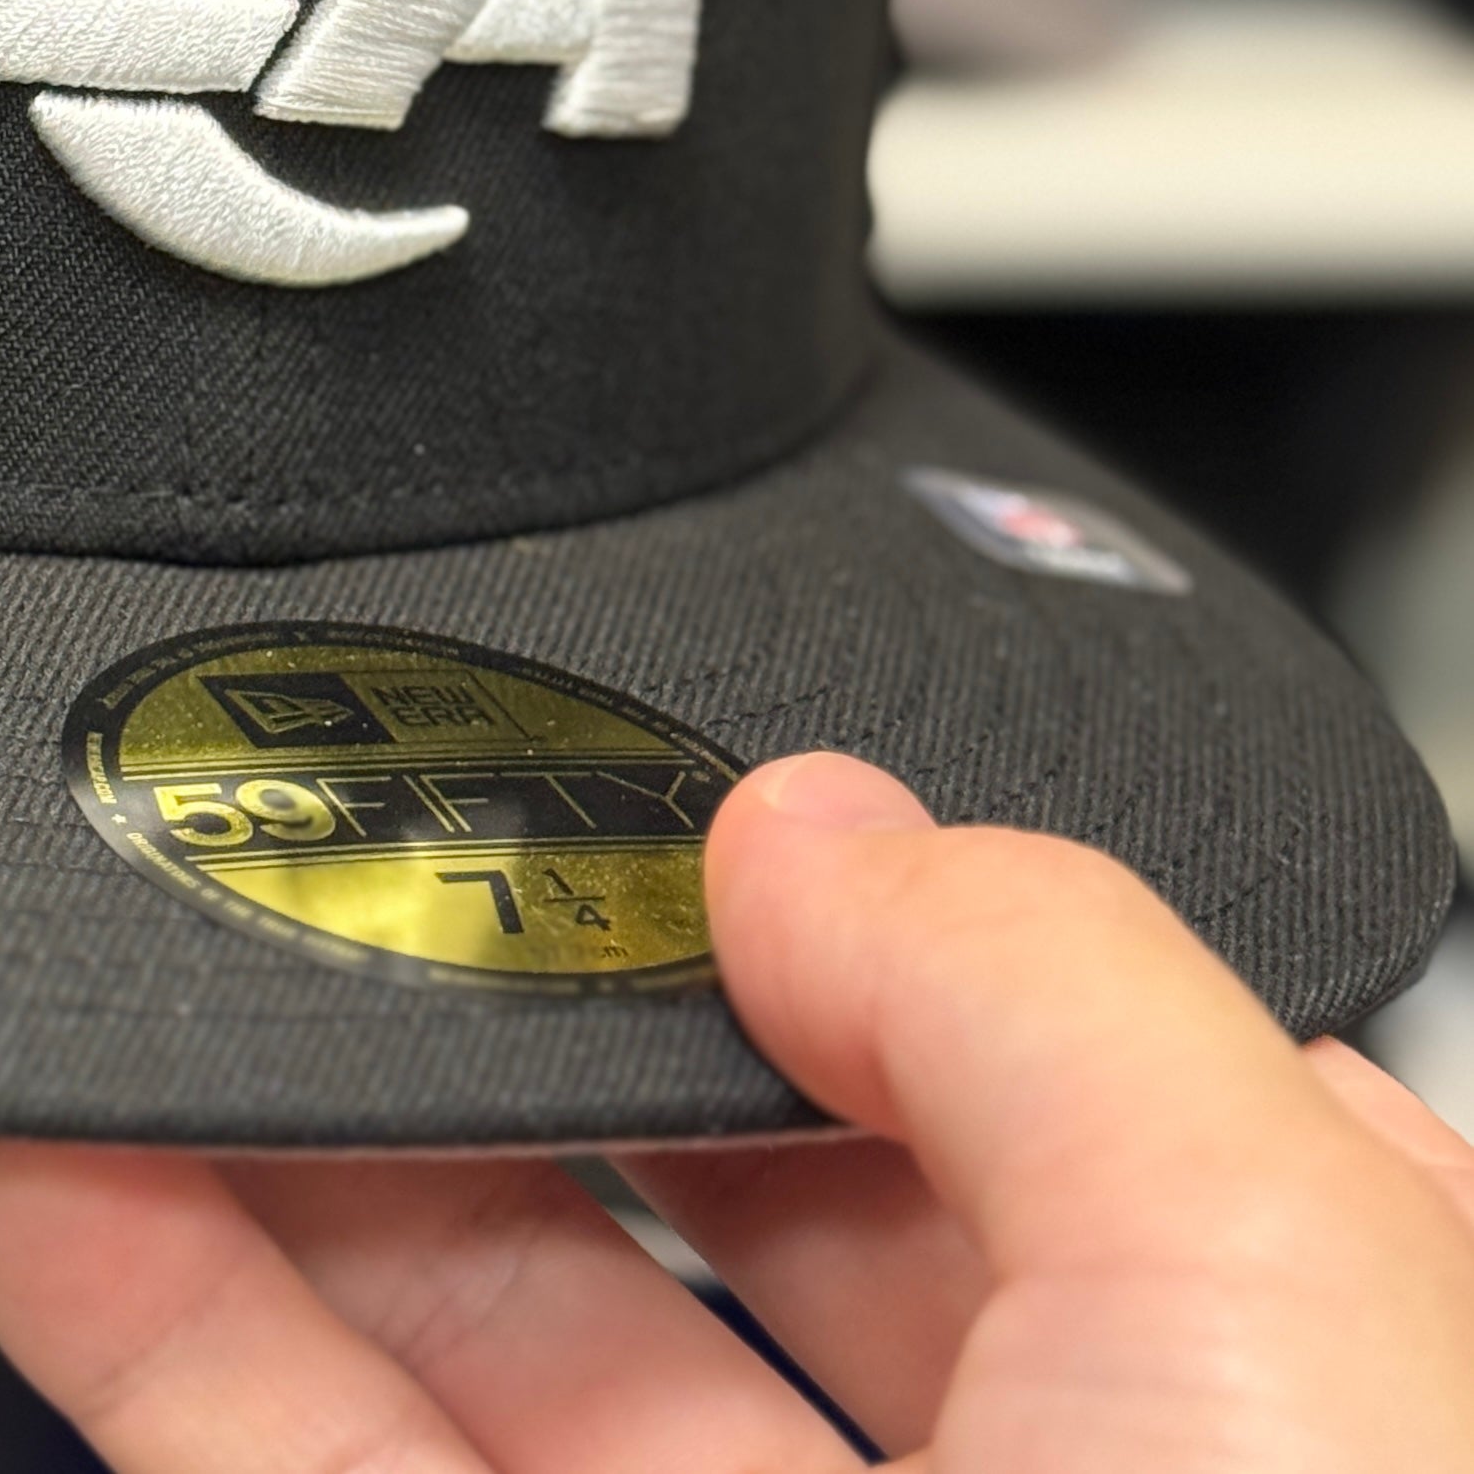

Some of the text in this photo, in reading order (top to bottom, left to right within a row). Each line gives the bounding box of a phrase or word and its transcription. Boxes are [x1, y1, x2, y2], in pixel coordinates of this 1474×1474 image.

[372, 685, 477, 706] NEW
[391, 706, 496, 726] ERA
[434, 869, 524, 934] 7
